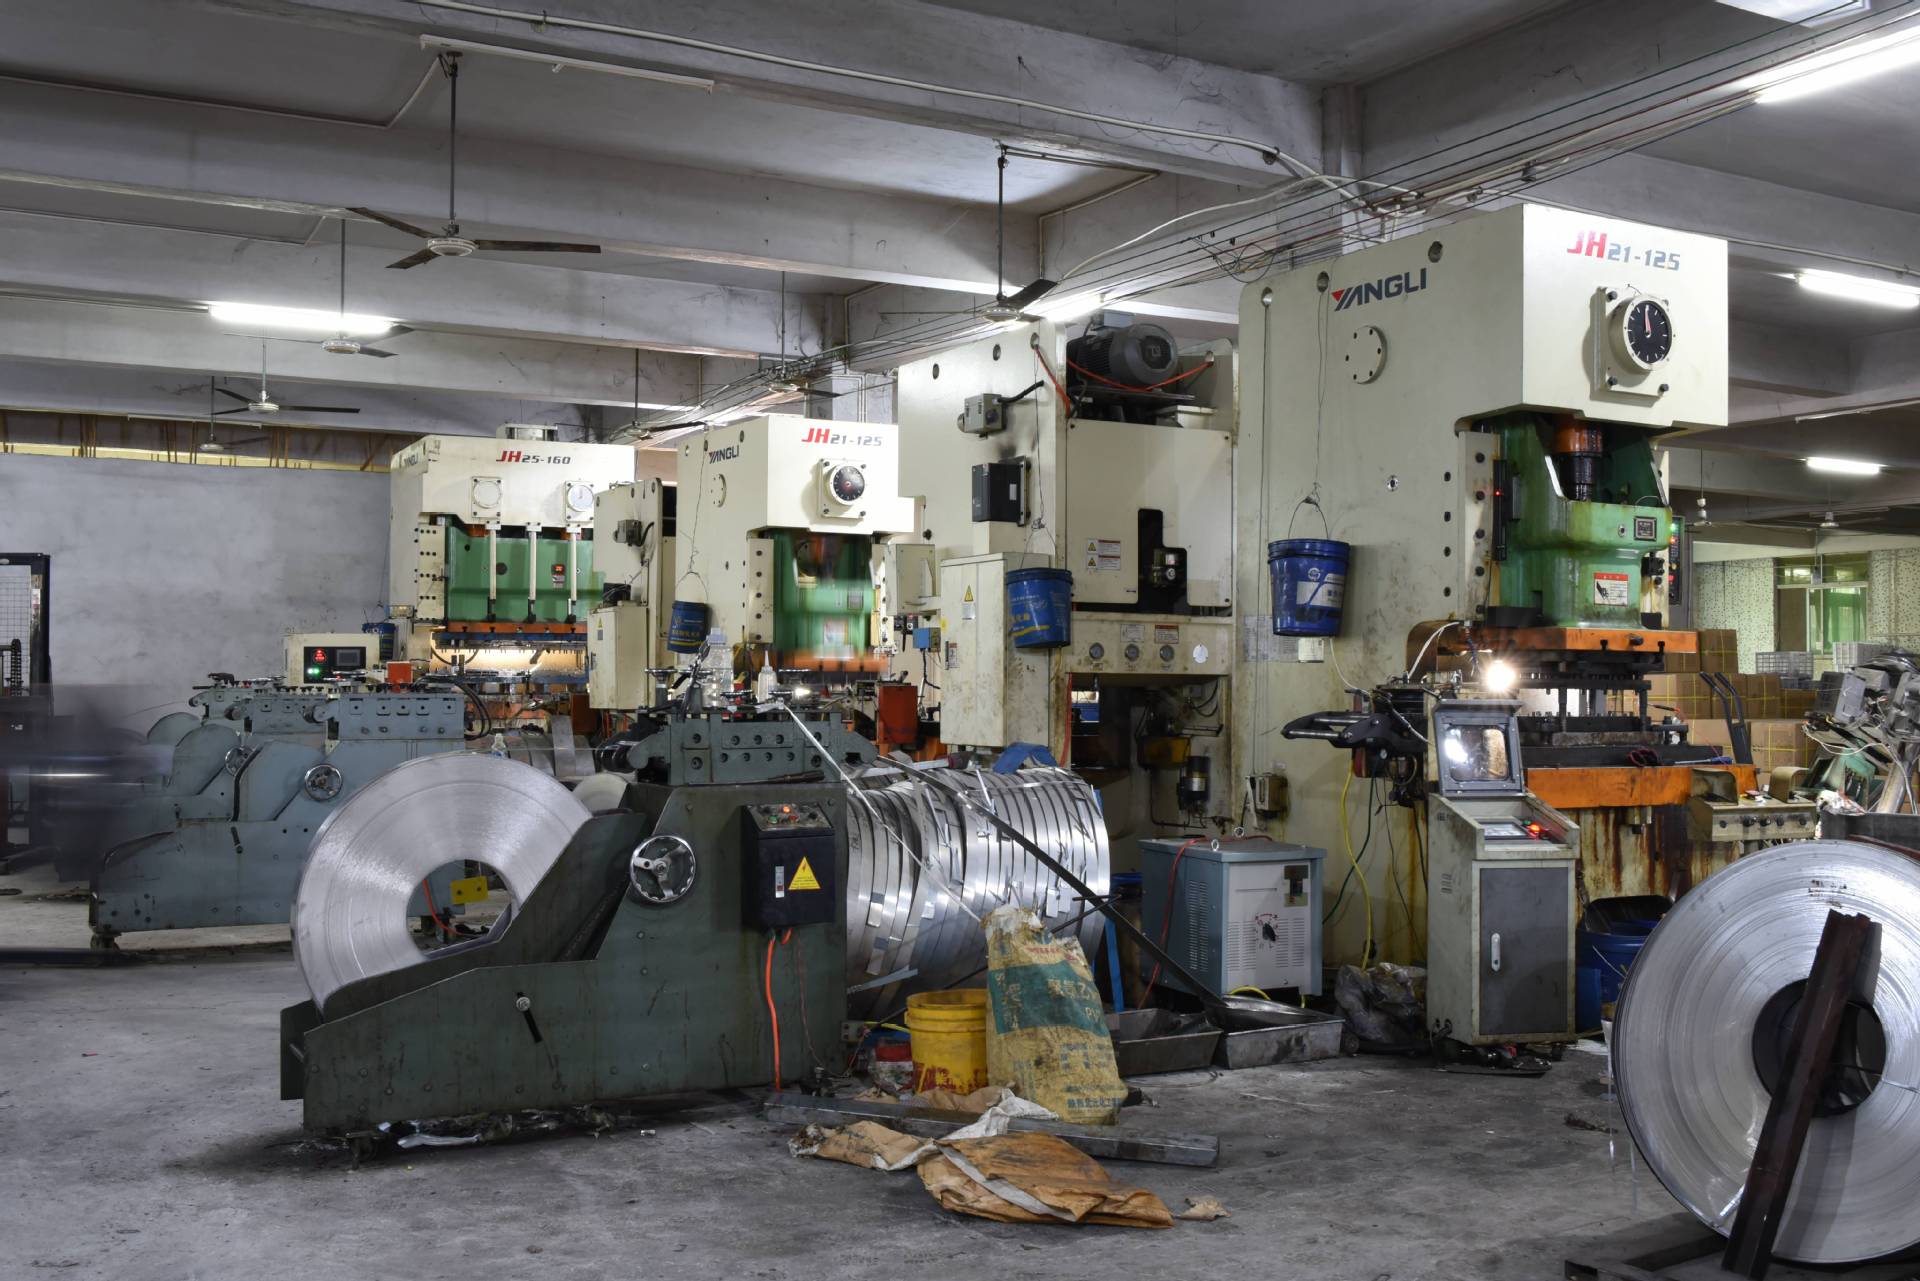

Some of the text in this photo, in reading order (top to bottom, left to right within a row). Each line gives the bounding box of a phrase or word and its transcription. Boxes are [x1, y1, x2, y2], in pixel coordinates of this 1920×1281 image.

[1567, 231, 1680, 271] JH21-125
[1331, 267, 1427, 312] YANGLI
[801, 428, 883, 446] JH21-125
[495, 450, 571, 464] JH25-160
[709, 444, 739, 464] YANGLI
